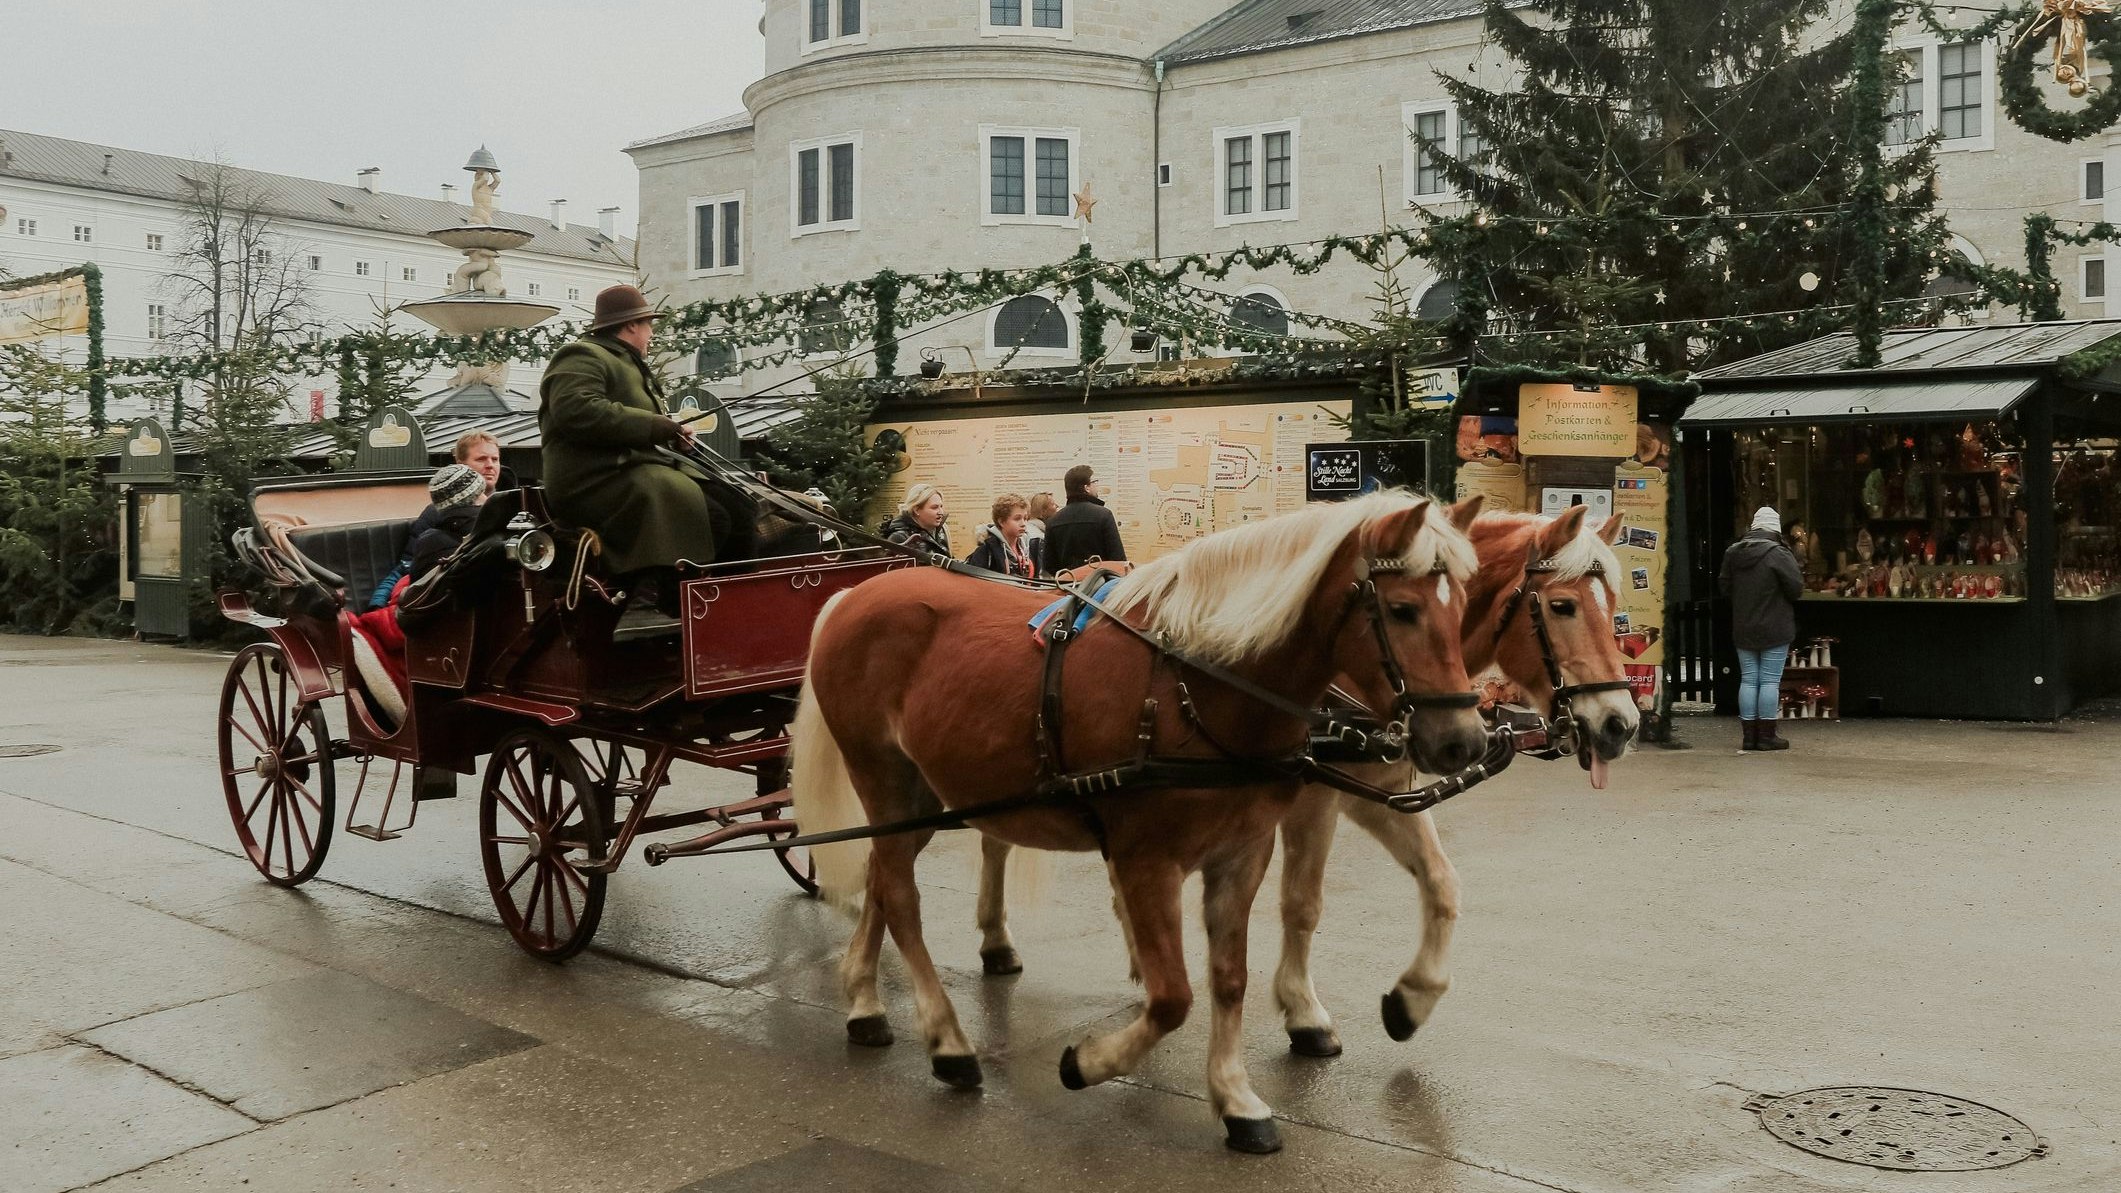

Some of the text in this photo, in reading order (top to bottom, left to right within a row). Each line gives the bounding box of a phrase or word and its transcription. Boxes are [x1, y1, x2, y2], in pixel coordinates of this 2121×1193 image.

[1423, 374, 1443, 391] WC
[1544, 414, 1612, 426] Postkarten &
[1313, 466, 1353, 477] Stille Nacht
[1317, 475, 1337, 486] Land
